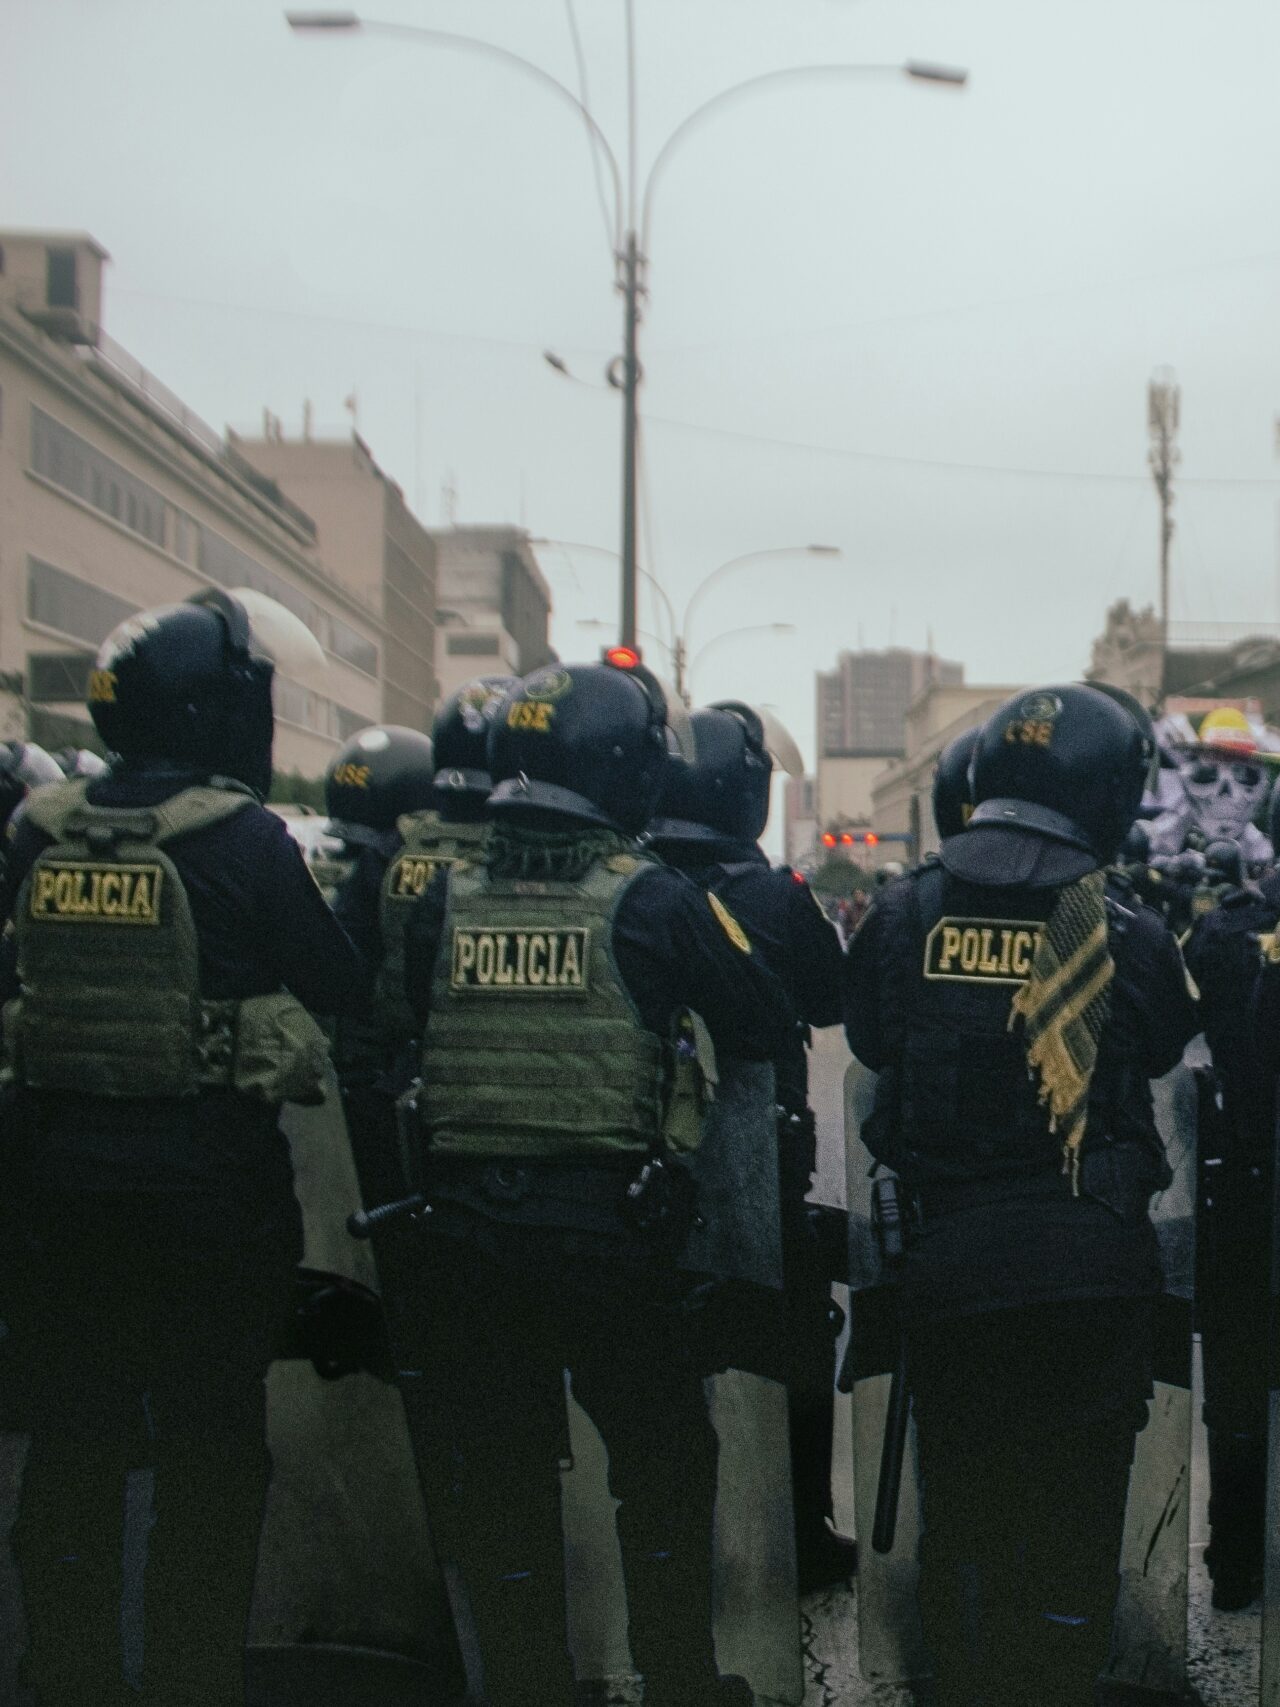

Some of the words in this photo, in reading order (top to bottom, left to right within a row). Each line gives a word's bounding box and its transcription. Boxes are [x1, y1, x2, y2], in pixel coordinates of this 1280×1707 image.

[509, 701, 557, 730] USE
[36, 869, 152, 917] POLICIA
[454, 934, 581, 985] POLICIA
